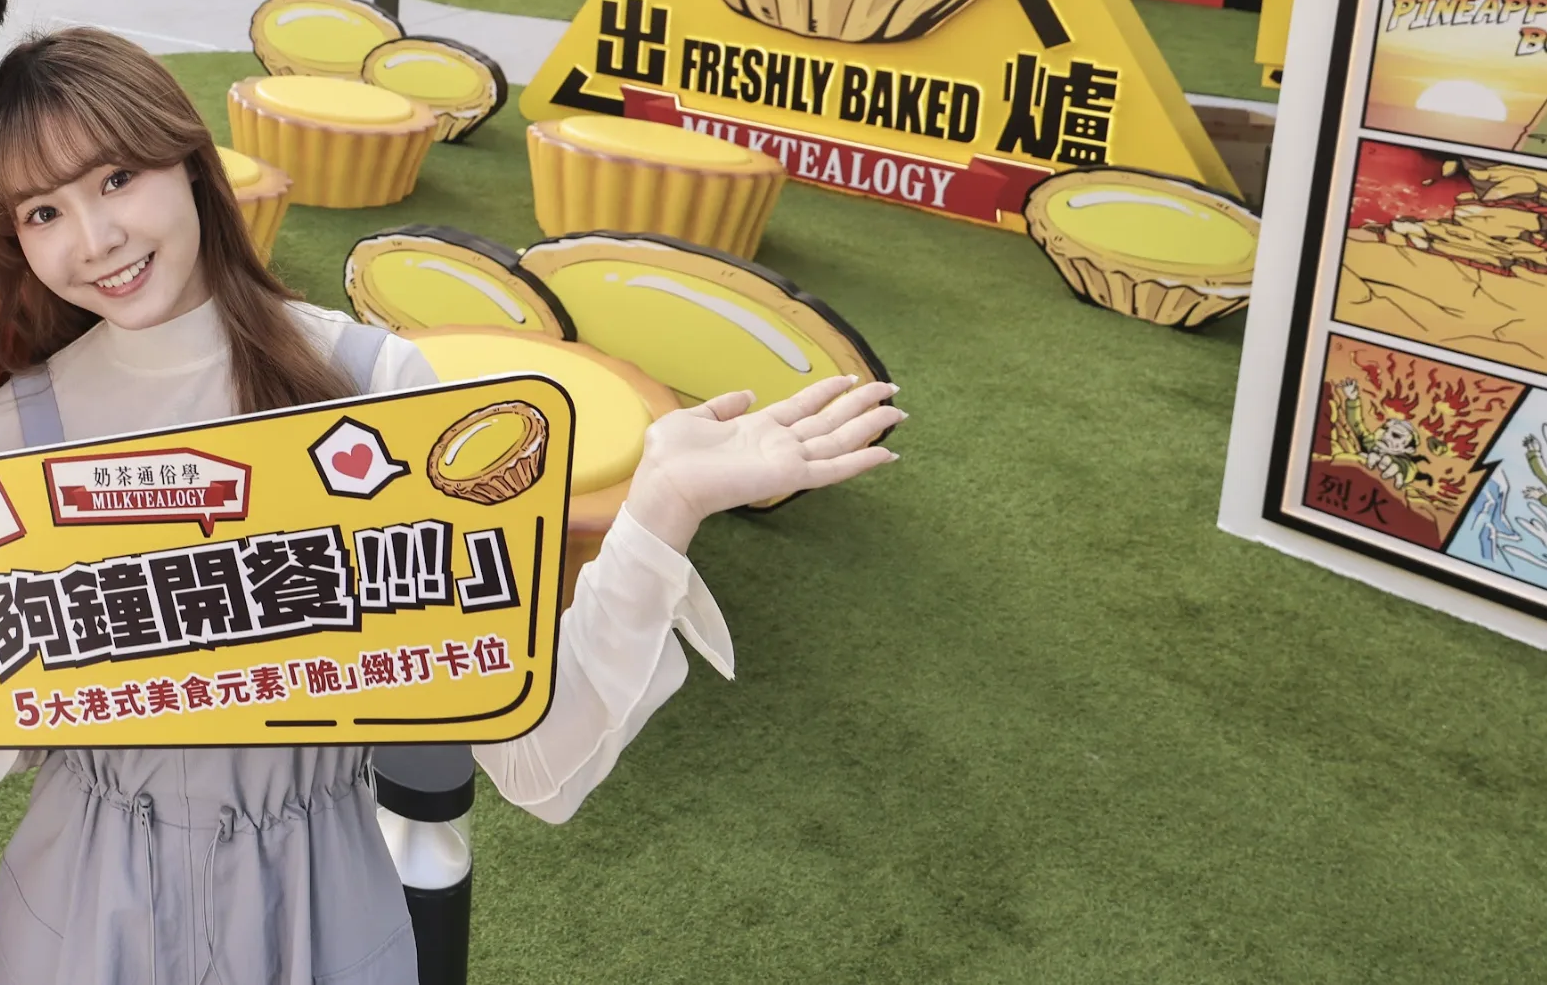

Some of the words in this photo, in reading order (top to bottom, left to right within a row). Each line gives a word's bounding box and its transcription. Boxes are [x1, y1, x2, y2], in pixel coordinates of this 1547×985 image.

[680, 37, 835, 116] FRESHLY
[838, 64, 982, 145] BAKED
[995, 51, 1121, 166] 爐
[91, 489, 208, 511] MILKTEALOGY
[92, 462, 203, 488] 奶茶通俗學
[1317, 473, 1390, 526] 烈火
